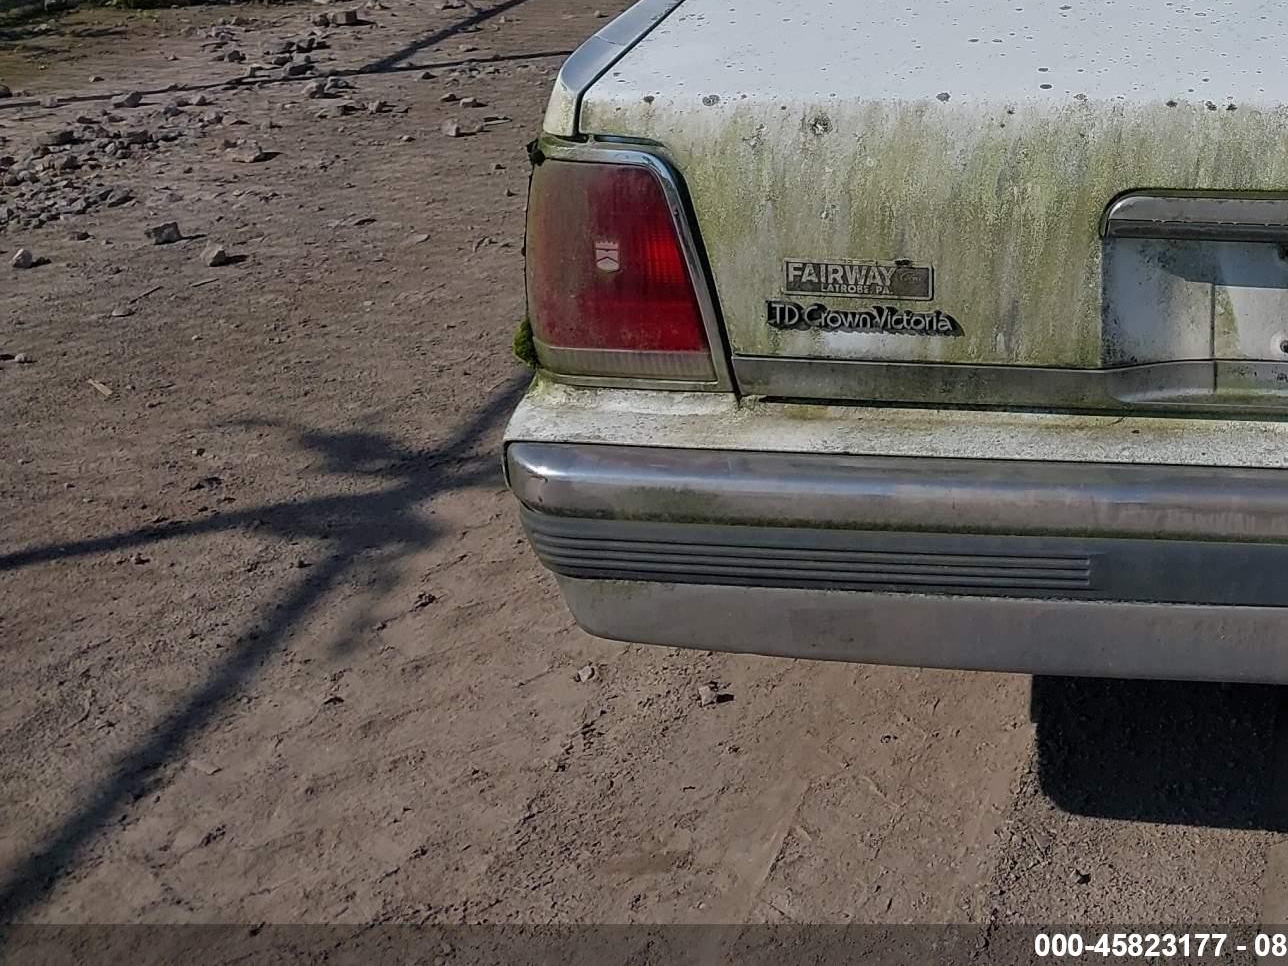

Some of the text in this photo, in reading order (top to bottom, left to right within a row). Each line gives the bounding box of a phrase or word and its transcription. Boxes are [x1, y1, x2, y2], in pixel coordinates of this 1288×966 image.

[787, 262, 896, 285] FAIRWAY
[804, 305, 871, 328] Crown
[874, 308, 953, 332] Victoria
